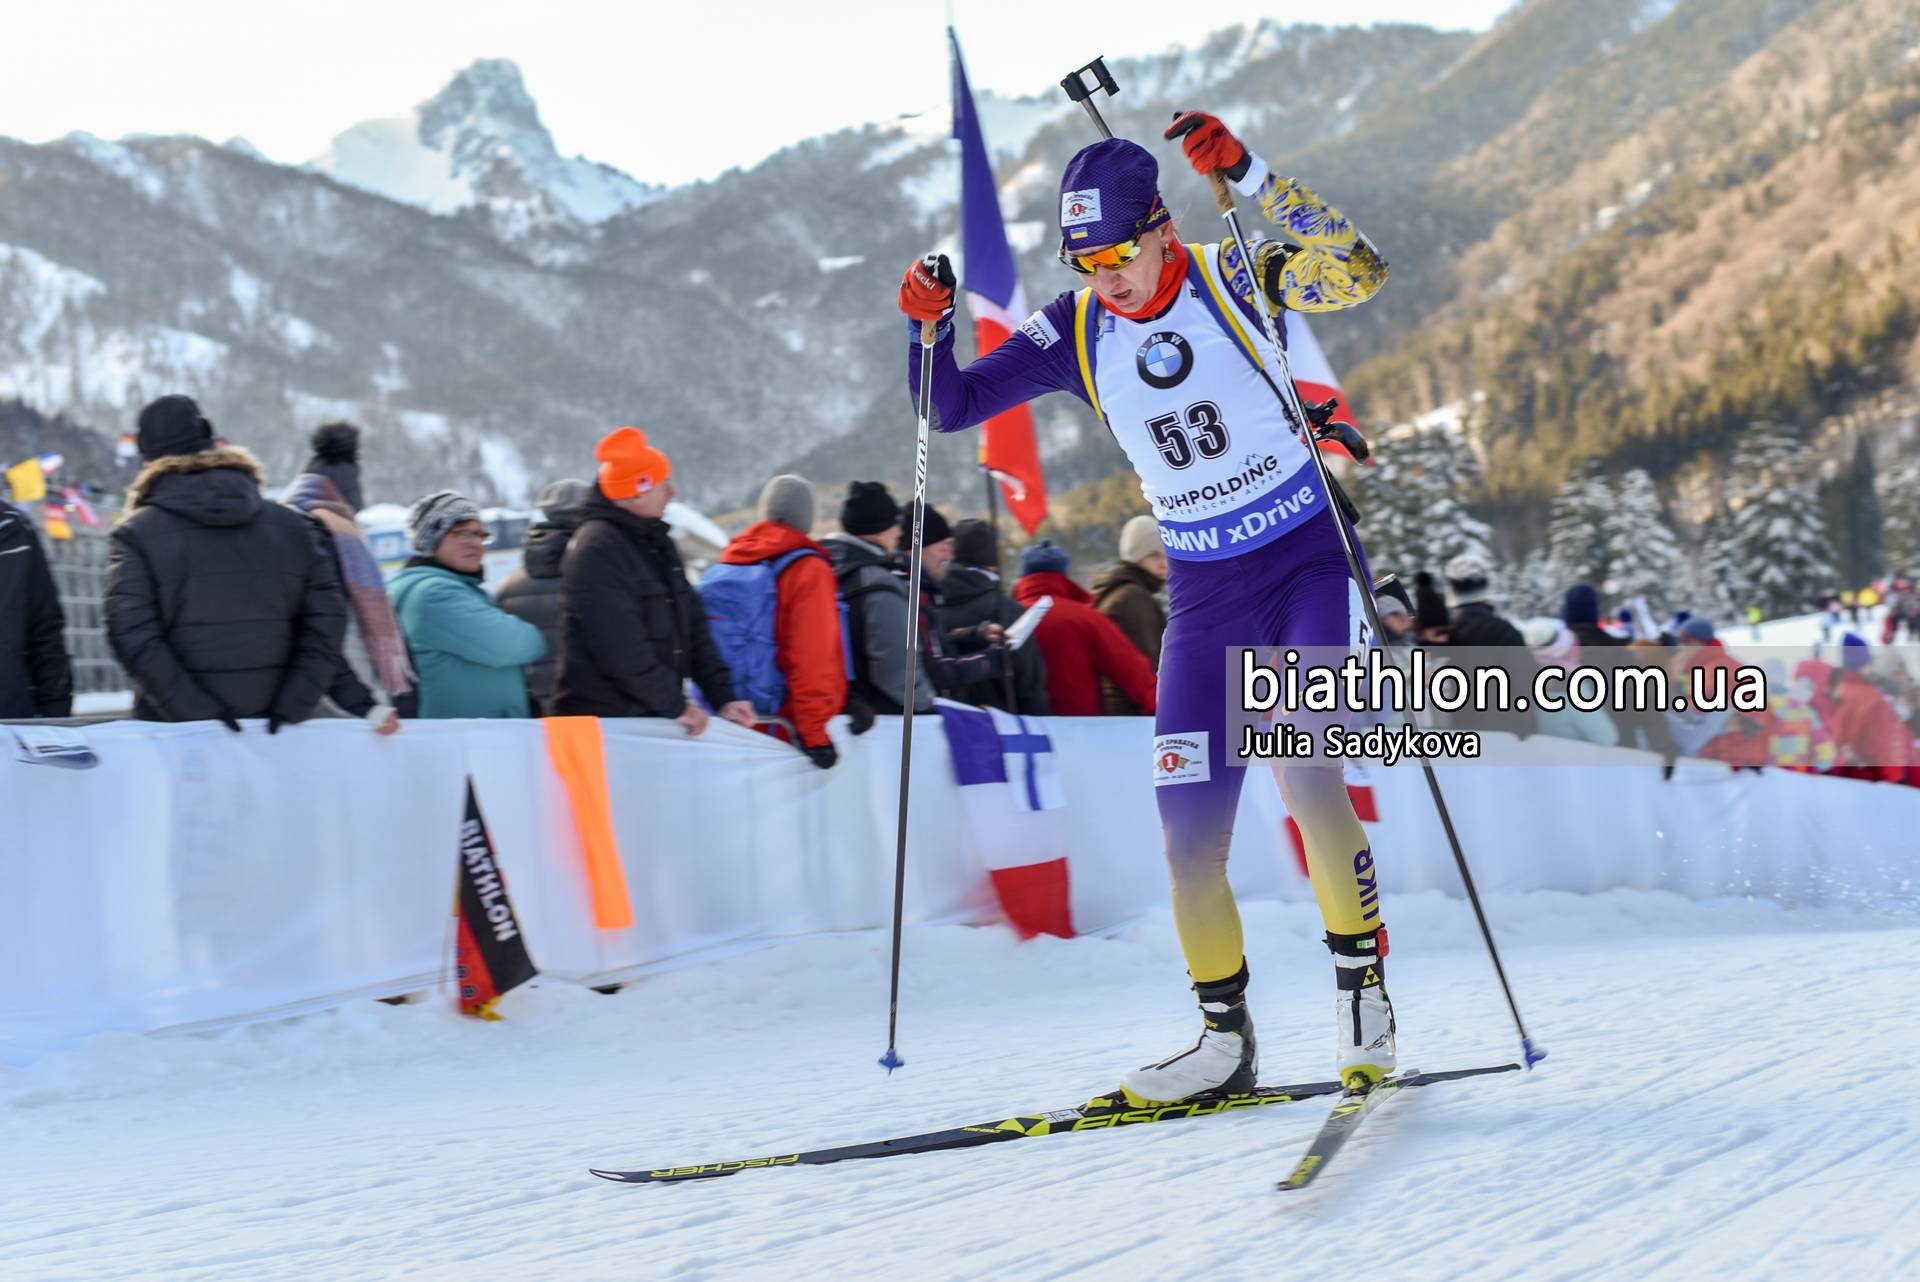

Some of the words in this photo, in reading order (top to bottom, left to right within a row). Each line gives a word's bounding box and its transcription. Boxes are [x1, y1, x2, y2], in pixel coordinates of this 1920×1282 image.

[1145, 400, 1230, 470] 53
[1158, 525, 1220, 552] BMW
[1229, 485, 1316, 545] xDrive
[462, 818, 518, 942] BIATHLON
[1354, 842, 1379, 921] UKR
[649, 1152, 800, 1179] FISCHER
